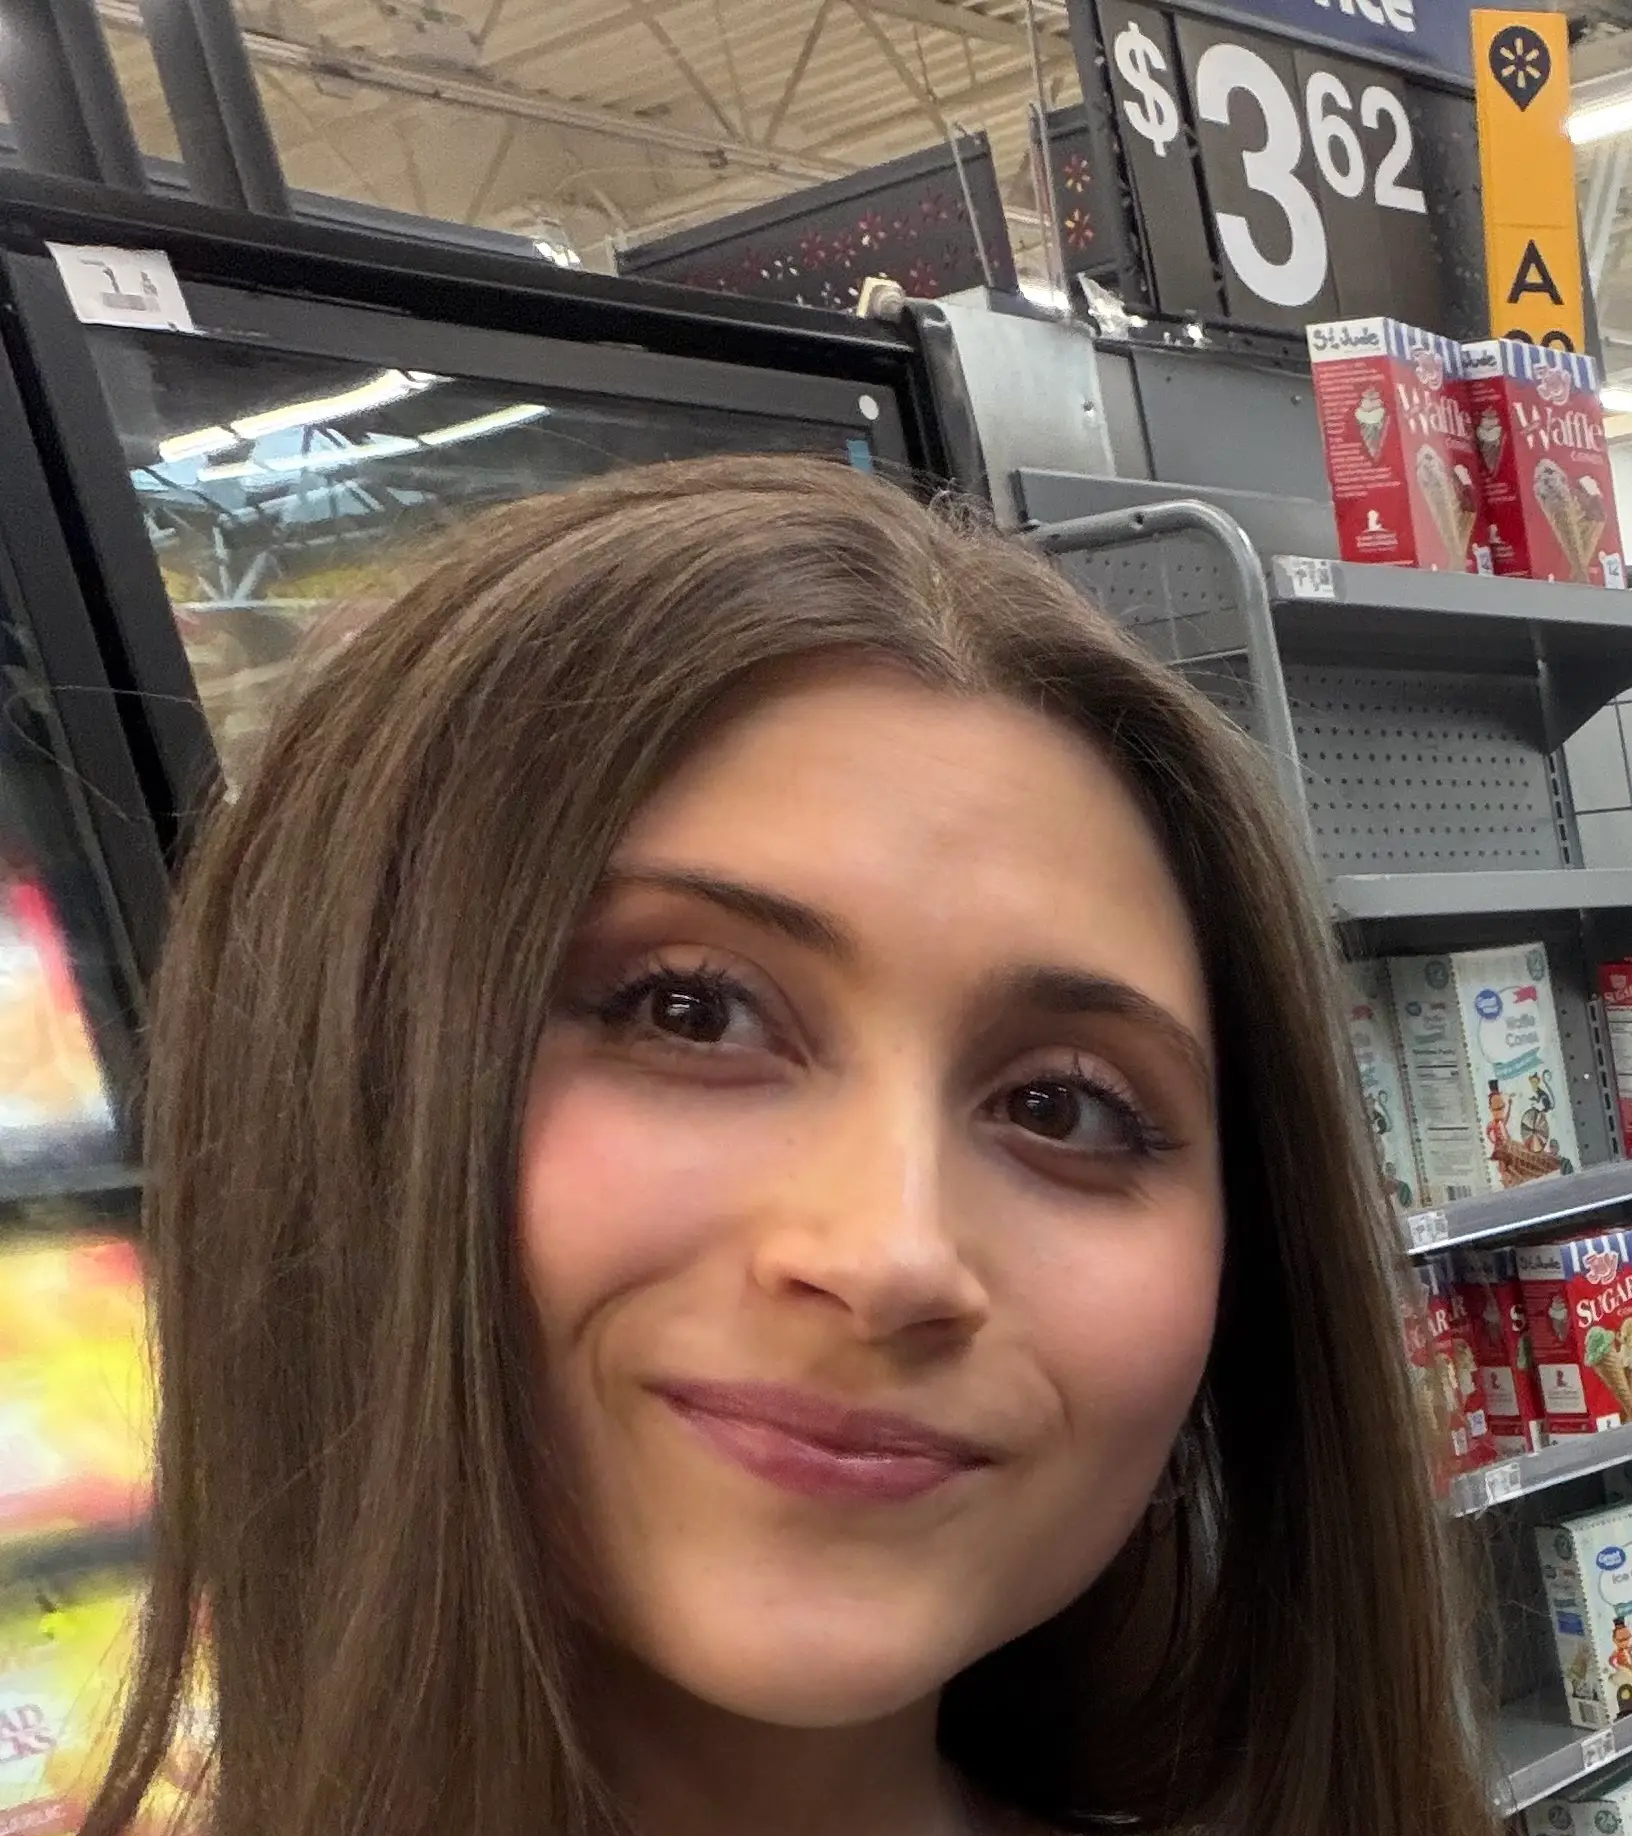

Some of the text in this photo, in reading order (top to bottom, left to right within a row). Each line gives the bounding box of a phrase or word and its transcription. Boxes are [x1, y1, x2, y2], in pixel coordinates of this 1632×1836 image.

[1507, 239, 1563, 305] A
[1398, 384, 1473, 438] Waffle
[1514, 401, 1604, 452] Waffle
